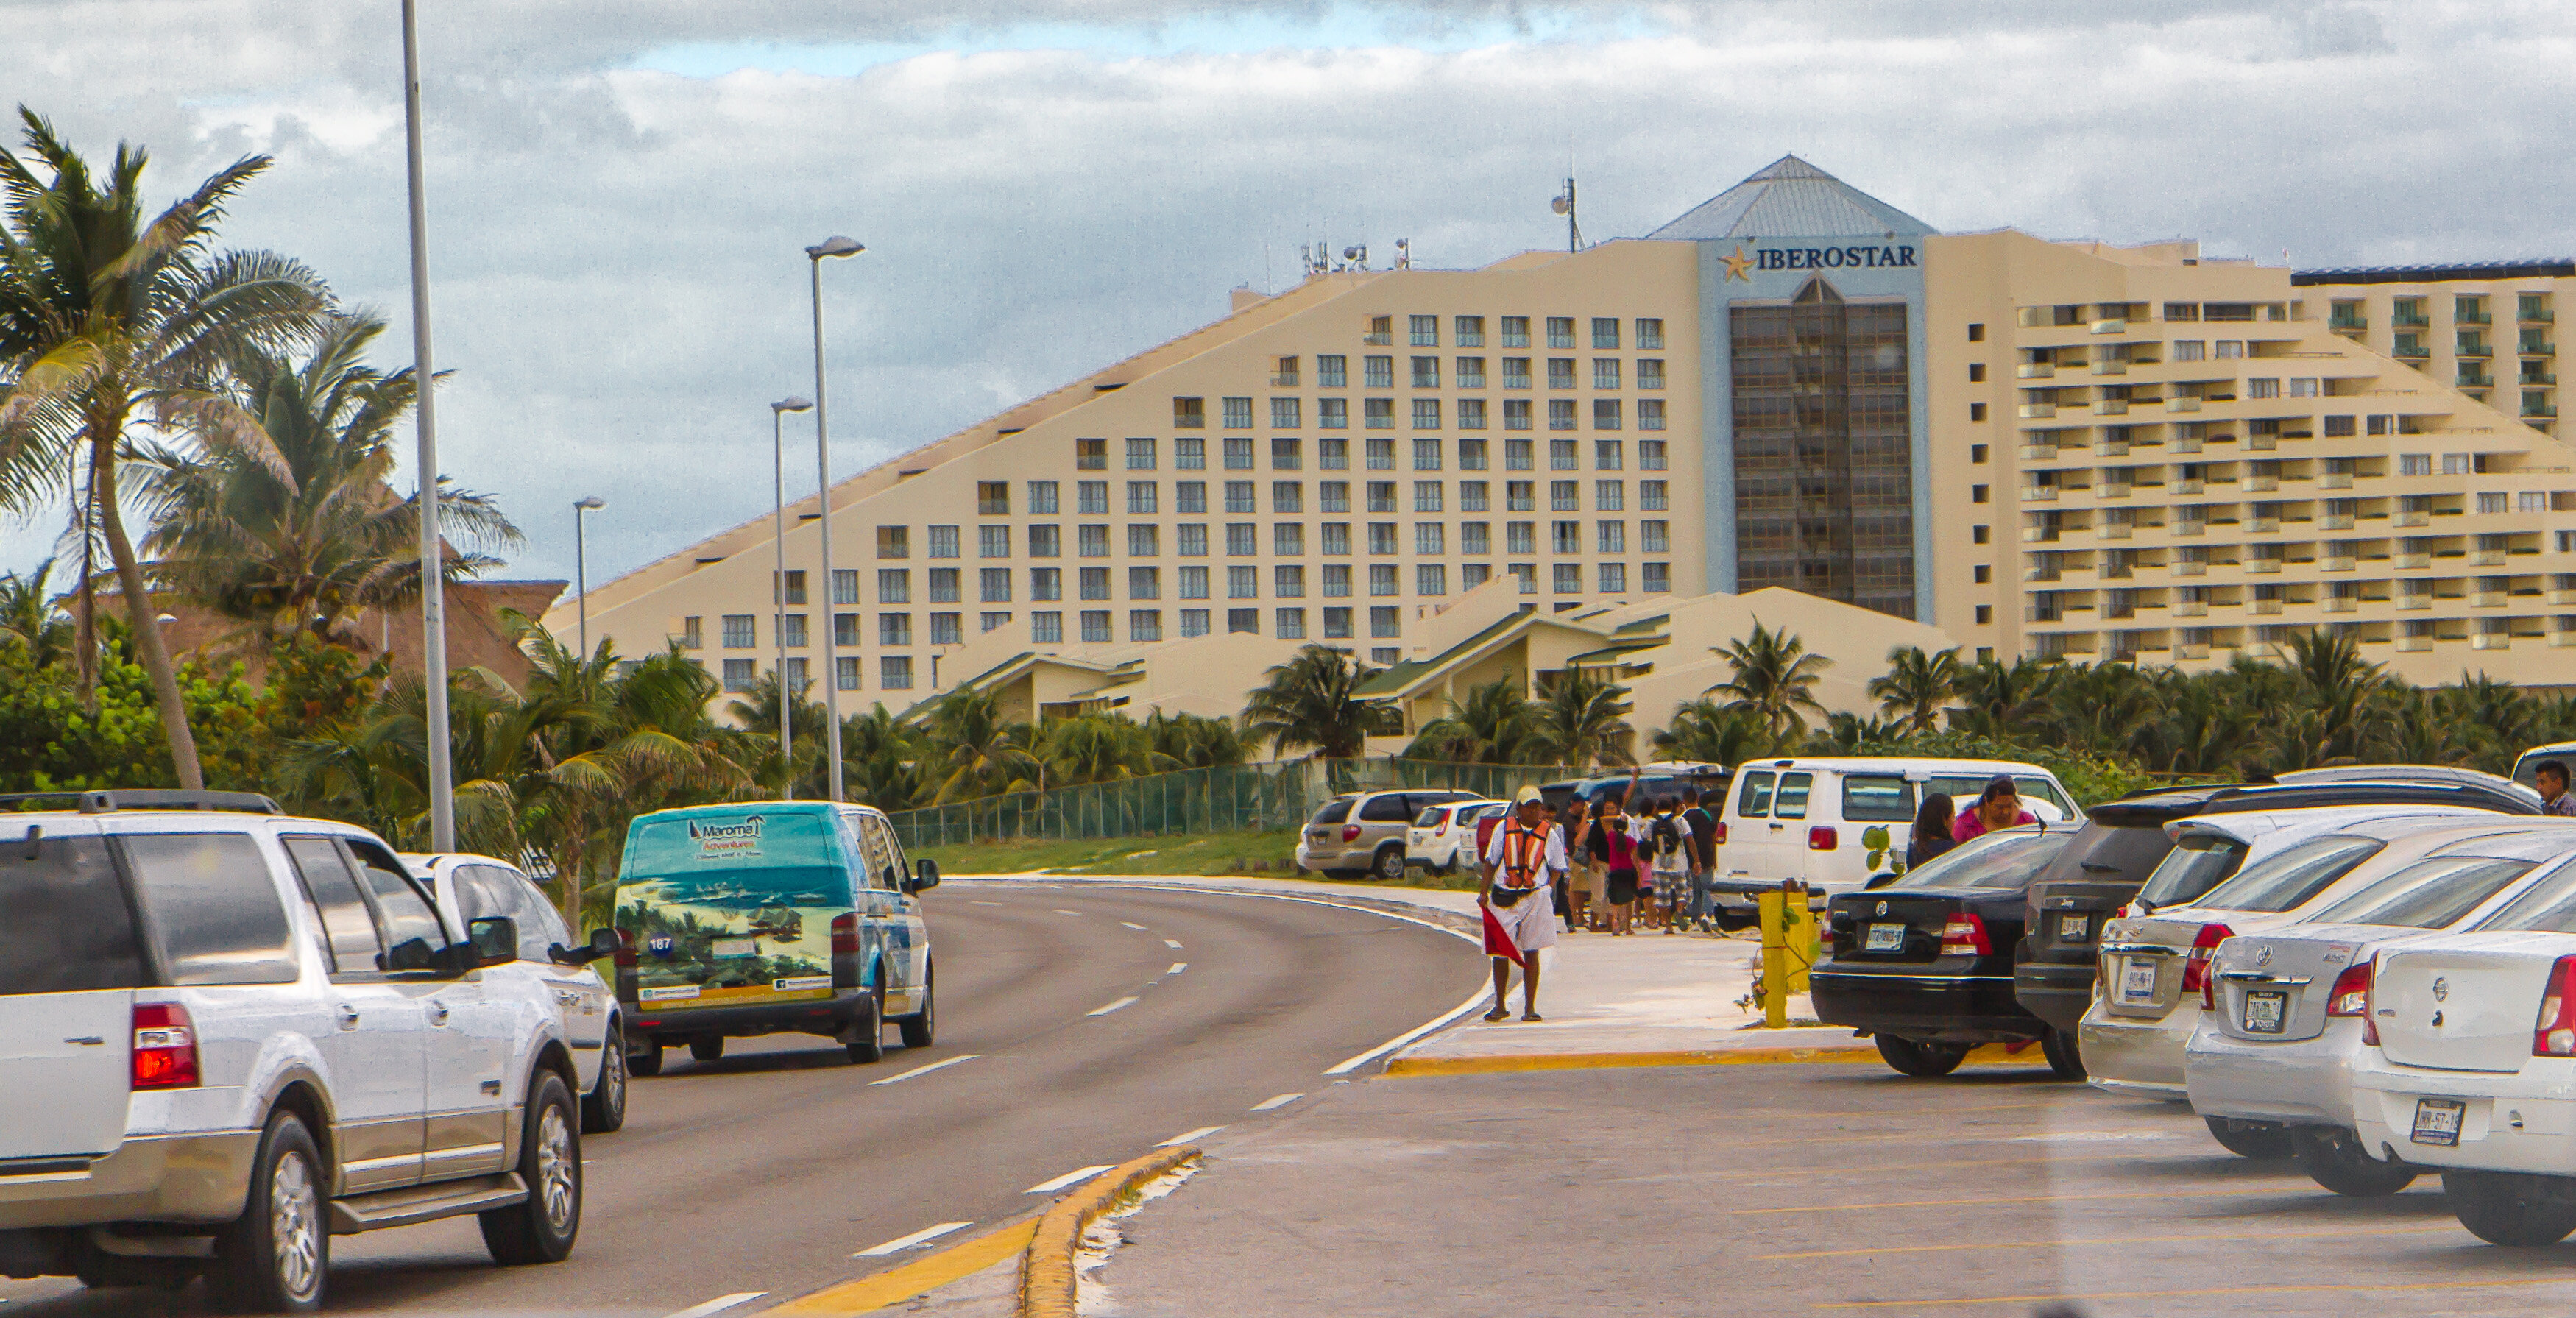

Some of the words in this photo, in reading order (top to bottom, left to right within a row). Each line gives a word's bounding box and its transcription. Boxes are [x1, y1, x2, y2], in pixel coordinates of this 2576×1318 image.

[1757, 245, 1918, 270] IBEROSTAR
[703, 825, 753, 837] Maroma
[703, 840, 756, 851] Adventures
[650, 937, 672, 951] 187
